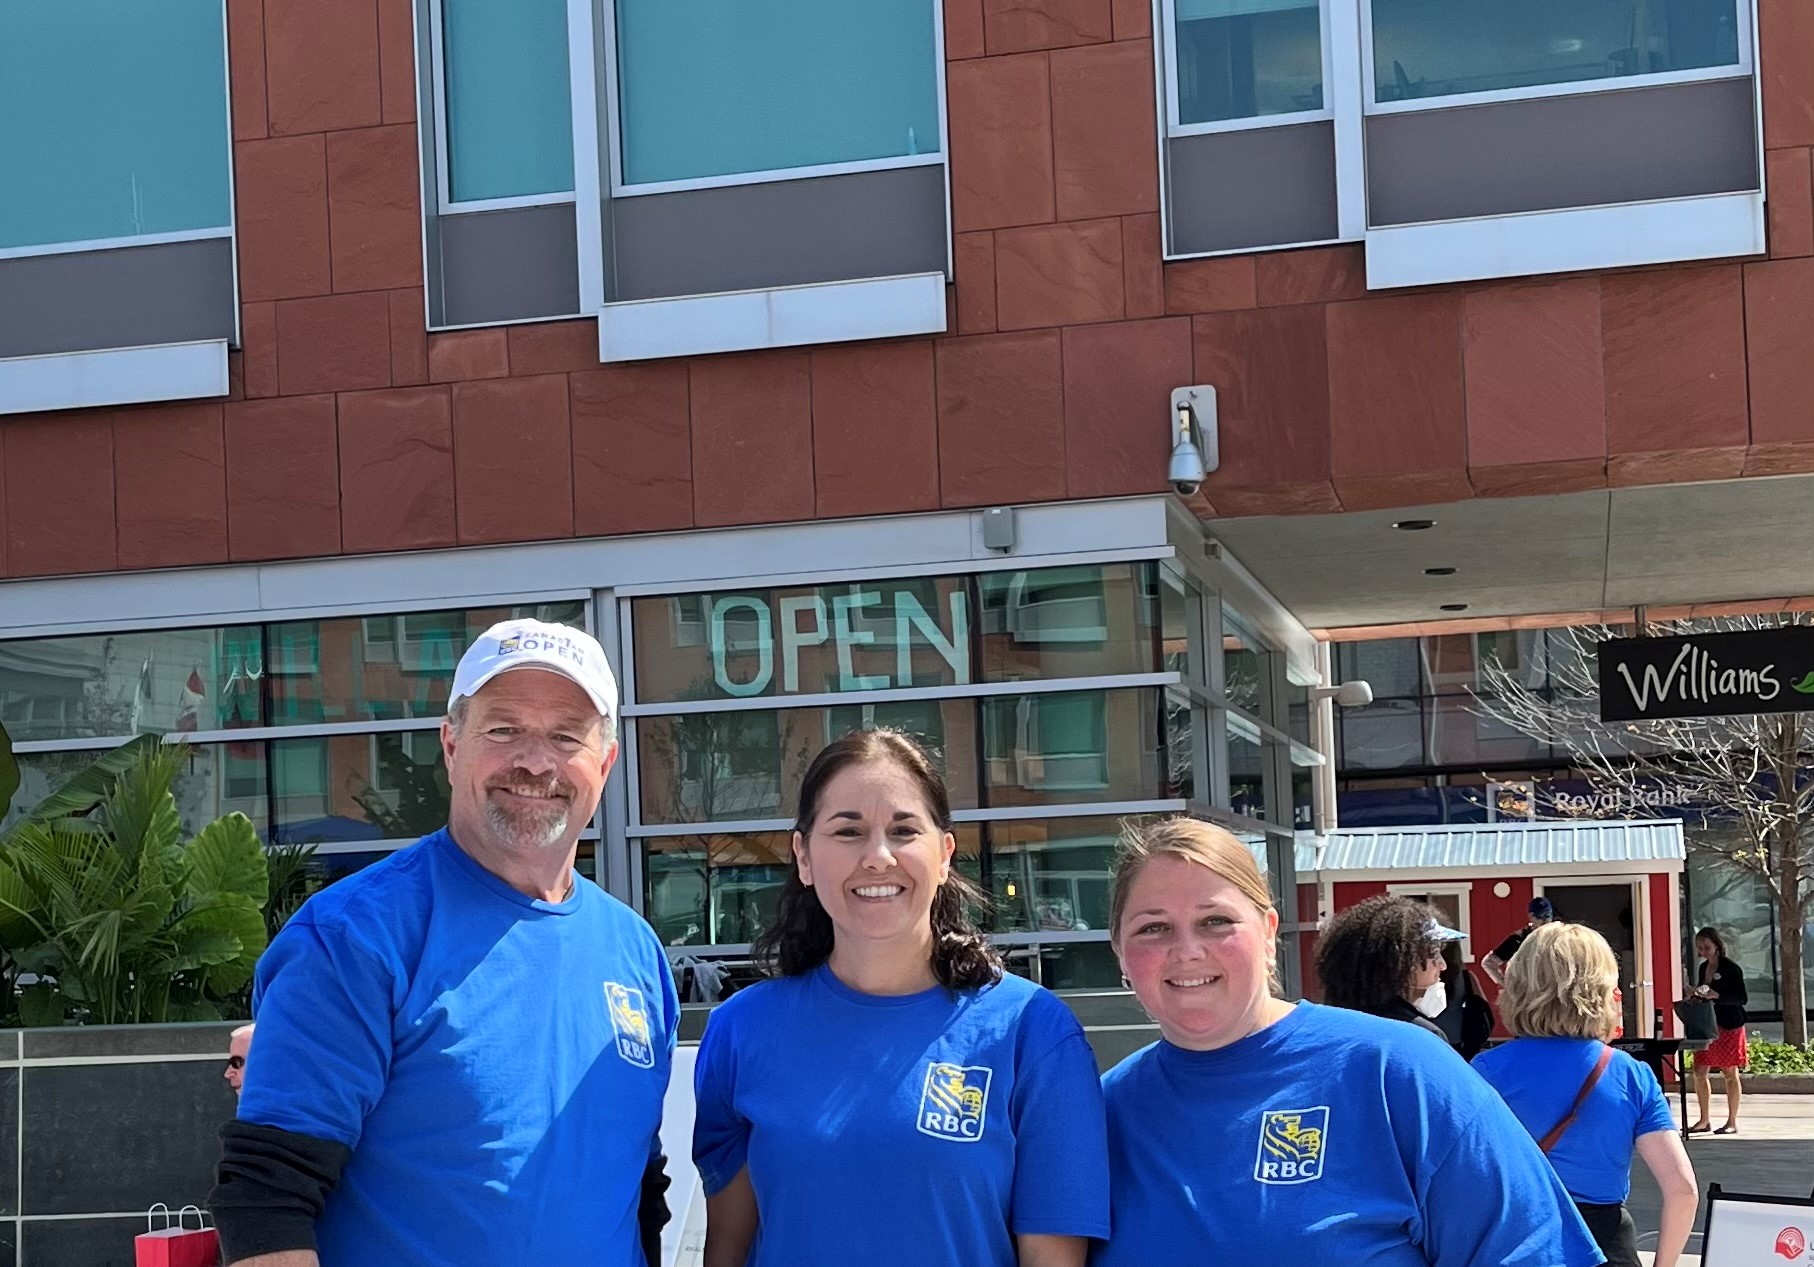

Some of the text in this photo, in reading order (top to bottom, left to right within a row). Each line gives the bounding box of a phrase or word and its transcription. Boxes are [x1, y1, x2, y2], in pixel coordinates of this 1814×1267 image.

[523, 639, 583, 667] OPEN
[711, 590, 970, 697] OPEN
[1617, 642, 1780, 712] Williams
[1555, 787, 1620, 814] Royal
[620, 1038, 650, 1064] RBC
[924, 1111, 978, 1137] RBC
[1262, 1159, 1316, 1178] RBC
